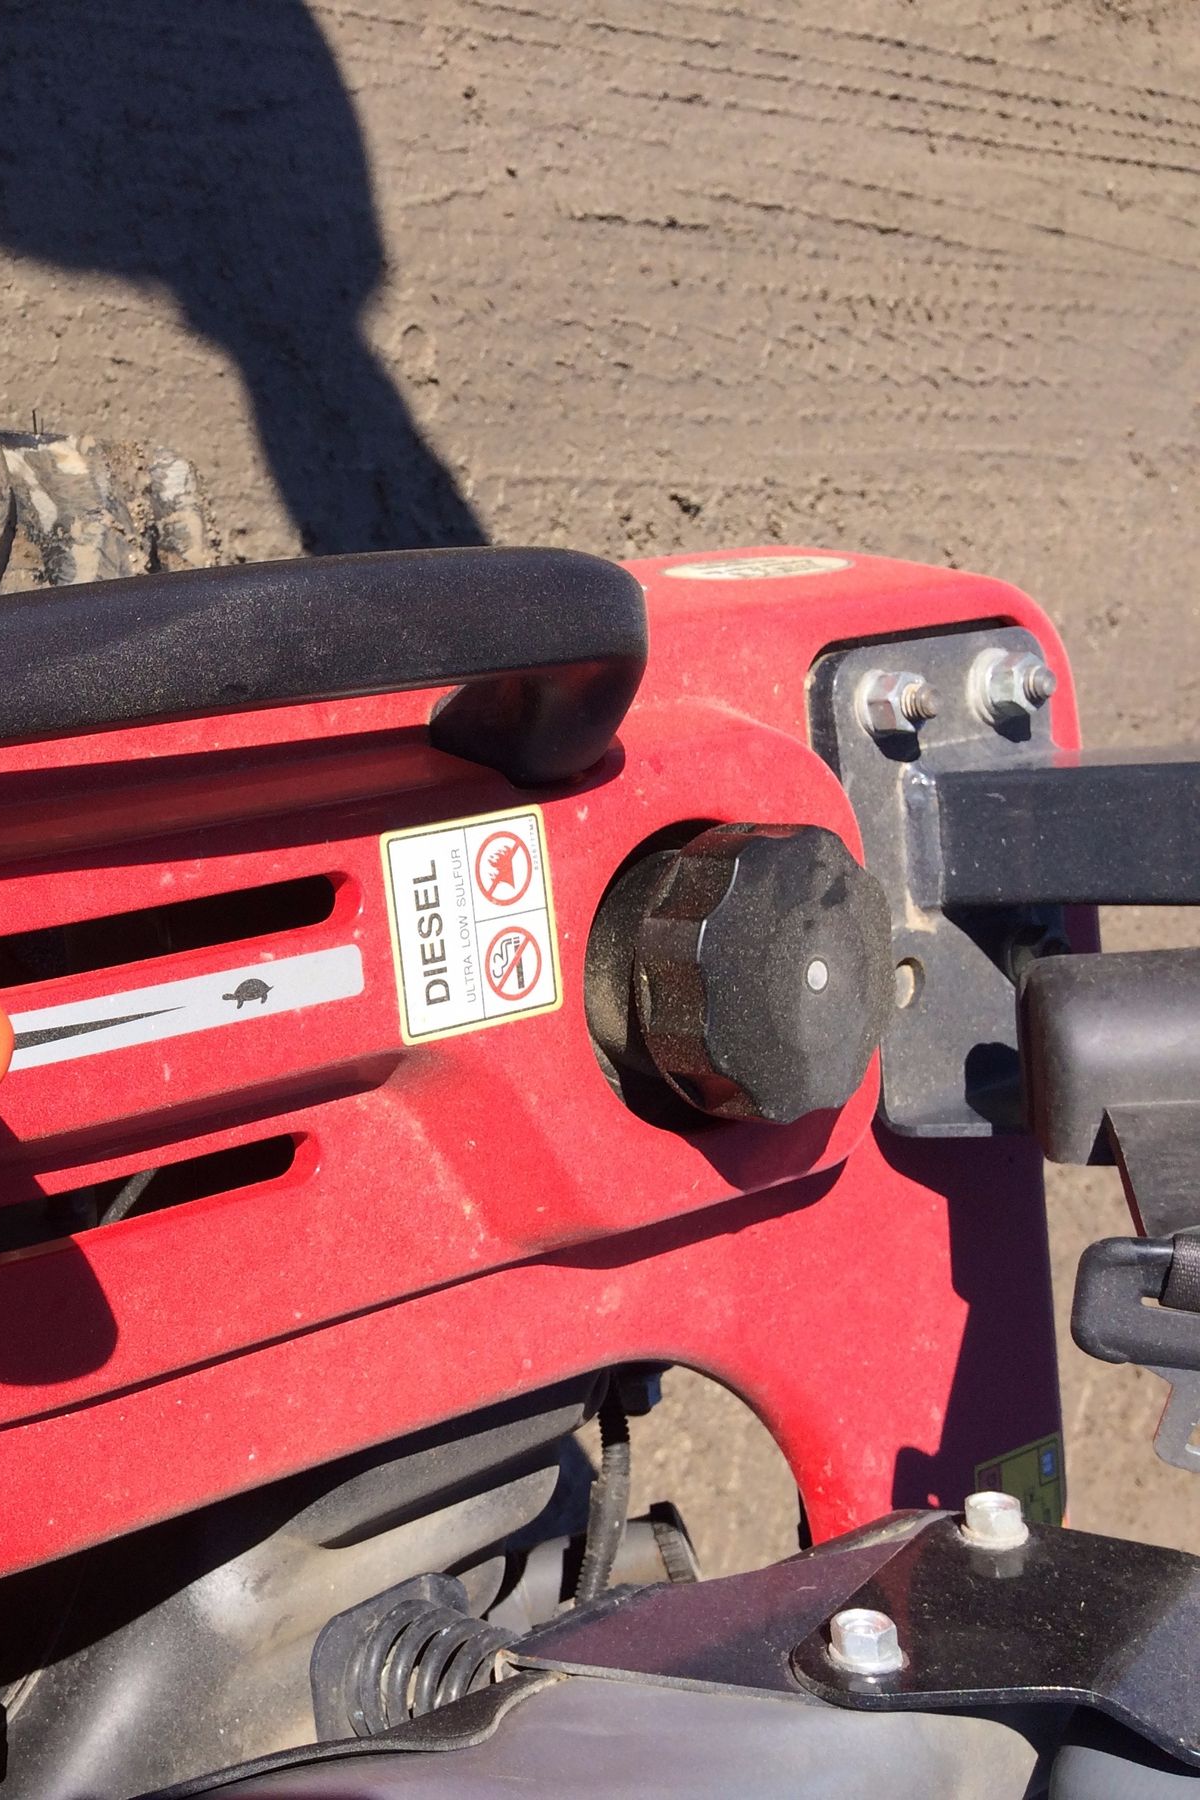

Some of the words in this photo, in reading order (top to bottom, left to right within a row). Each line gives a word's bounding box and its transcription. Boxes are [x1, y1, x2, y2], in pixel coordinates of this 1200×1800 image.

[451, 848, 466, 907] SULFUR
[413, 860, 450, 1006] DIESEL
[459, 915, 470, 948] LOW
[464, 954, 476, 1003] ULTRA
